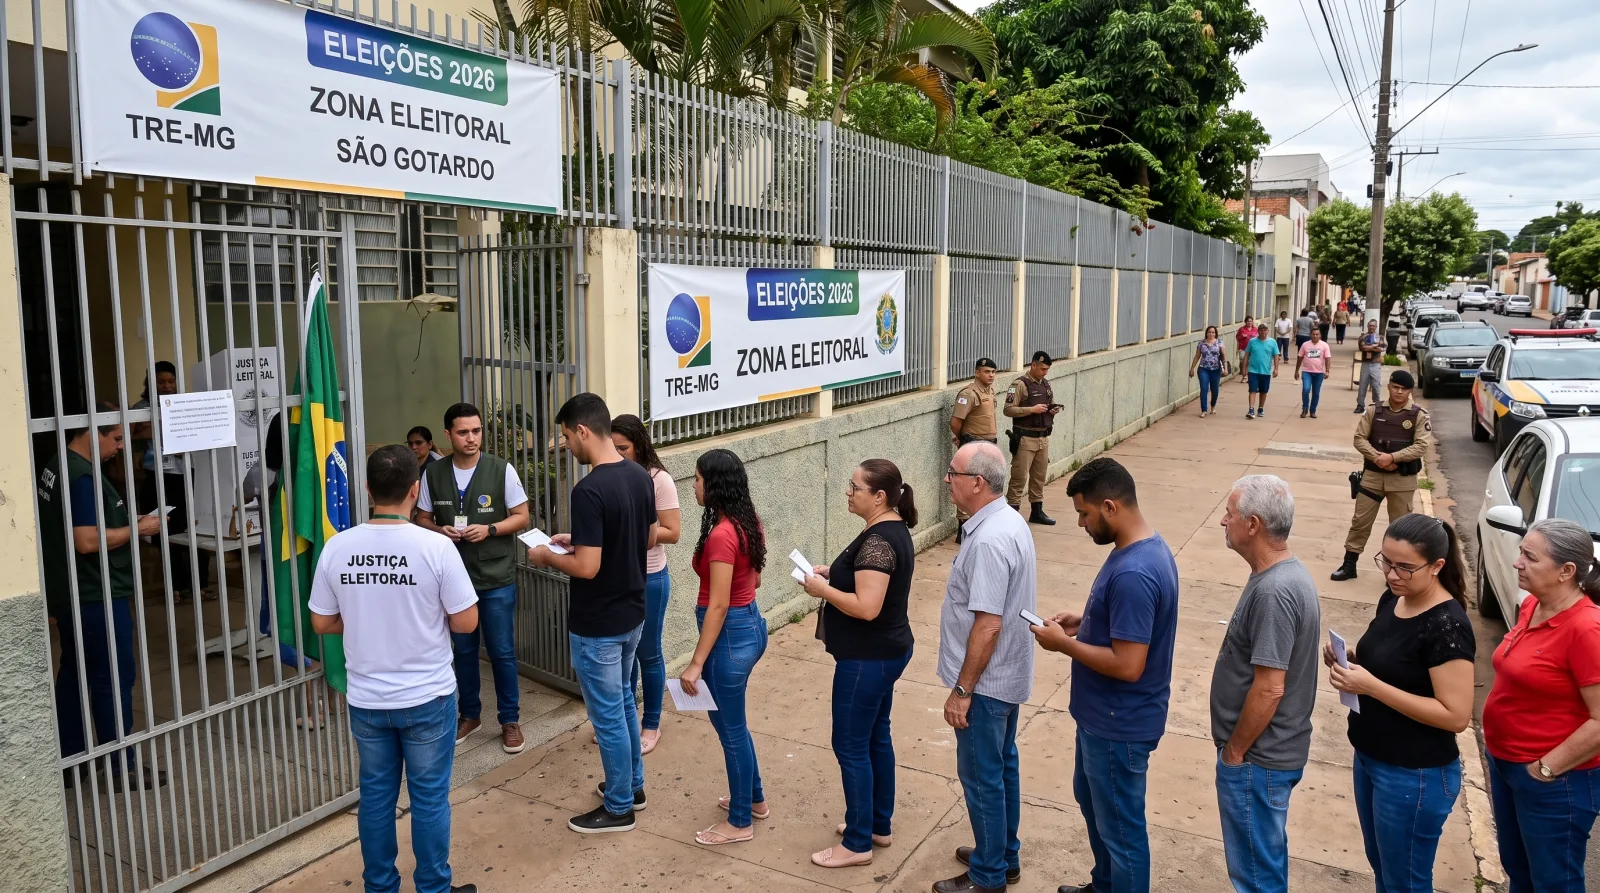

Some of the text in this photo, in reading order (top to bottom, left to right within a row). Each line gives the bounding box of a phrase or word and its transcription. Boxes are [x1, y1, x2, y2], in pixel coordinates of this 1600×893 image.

[324, 30, 495, 92] ELEIÇÕES 2026
[125, 114, 236, 151] TRE-MG
[309, 85, 511, 145] ZONA ELEITORAL
[337, 136, 495, 181] SÃO GOTARDO
[756, 278, 853, 312] ELEIÇÕES 2026
[235, 357, 270, 370] JUSTÇA
[736, 345, 788, 377] ZONA
[791, 336, 869, 370] ELEITORAL
[664, 373, 719, 398] TRE-MG
[340, 573, 418, 586] ELEITORAL
[347, 554, 409, 571] JUSTIÇA
